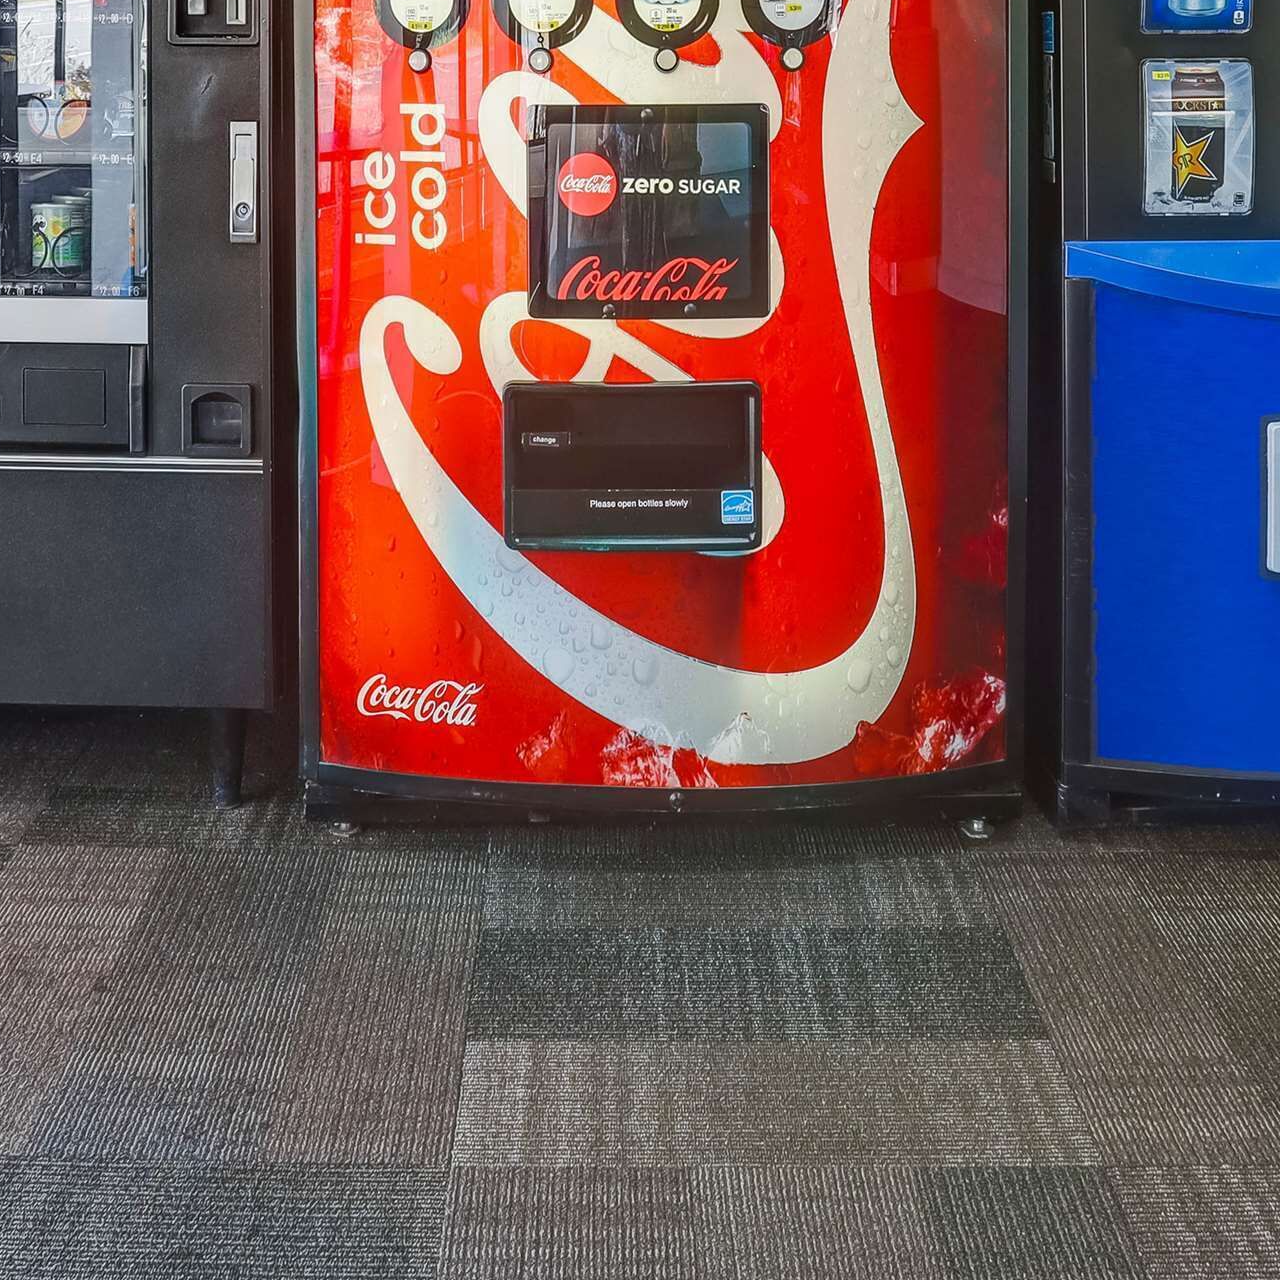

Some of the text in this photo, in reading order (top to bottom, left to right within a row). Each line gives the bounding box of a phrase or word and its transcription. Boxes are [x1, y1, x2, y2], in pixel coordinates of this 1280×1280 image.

[30, 153, 42, 163] E4
[400, 103, 447, 250] cold
[561, 174, 613, 193] Coca-Cola
[623, 178, 740, 194] zero SUGAR
[355, 151, 396, 245] ice
[32, 285, 44, 295] F4
[128, 286, 140, 296] F6
[532, 436, 556, 444] change
[590, 499, 689, 508] Please open bottles slowly
[357, 673, 484, 726] Coca-Cola
